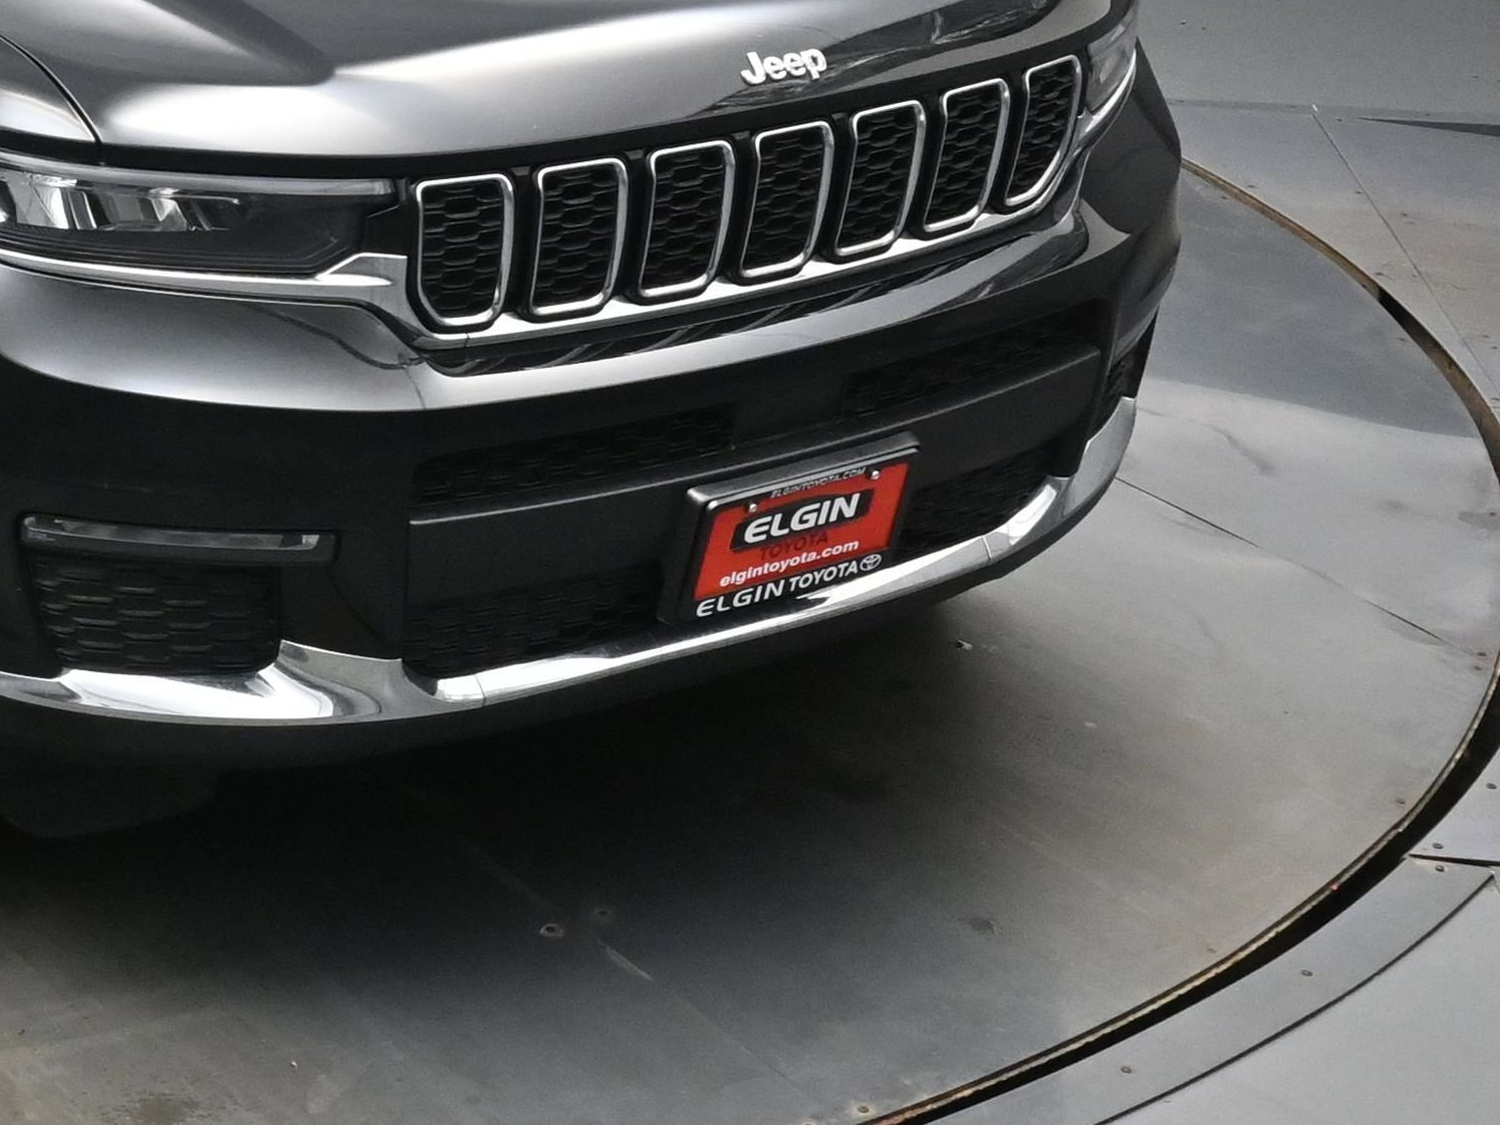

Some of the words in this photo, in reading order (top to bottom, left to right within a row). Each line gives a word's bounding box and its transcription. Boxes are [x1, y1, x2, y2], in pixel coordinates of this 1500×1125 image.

[740, 48, 828, 84] Jeep
[743, 493, 861, 544] ELGIN
[719, 540, 860, 588] elgintoyota.com
[759, 532, 830, 561] TOYOTA
[696, 581, 785, 617] ELGIN
[789, 561, 859, 592] TOYOTA
